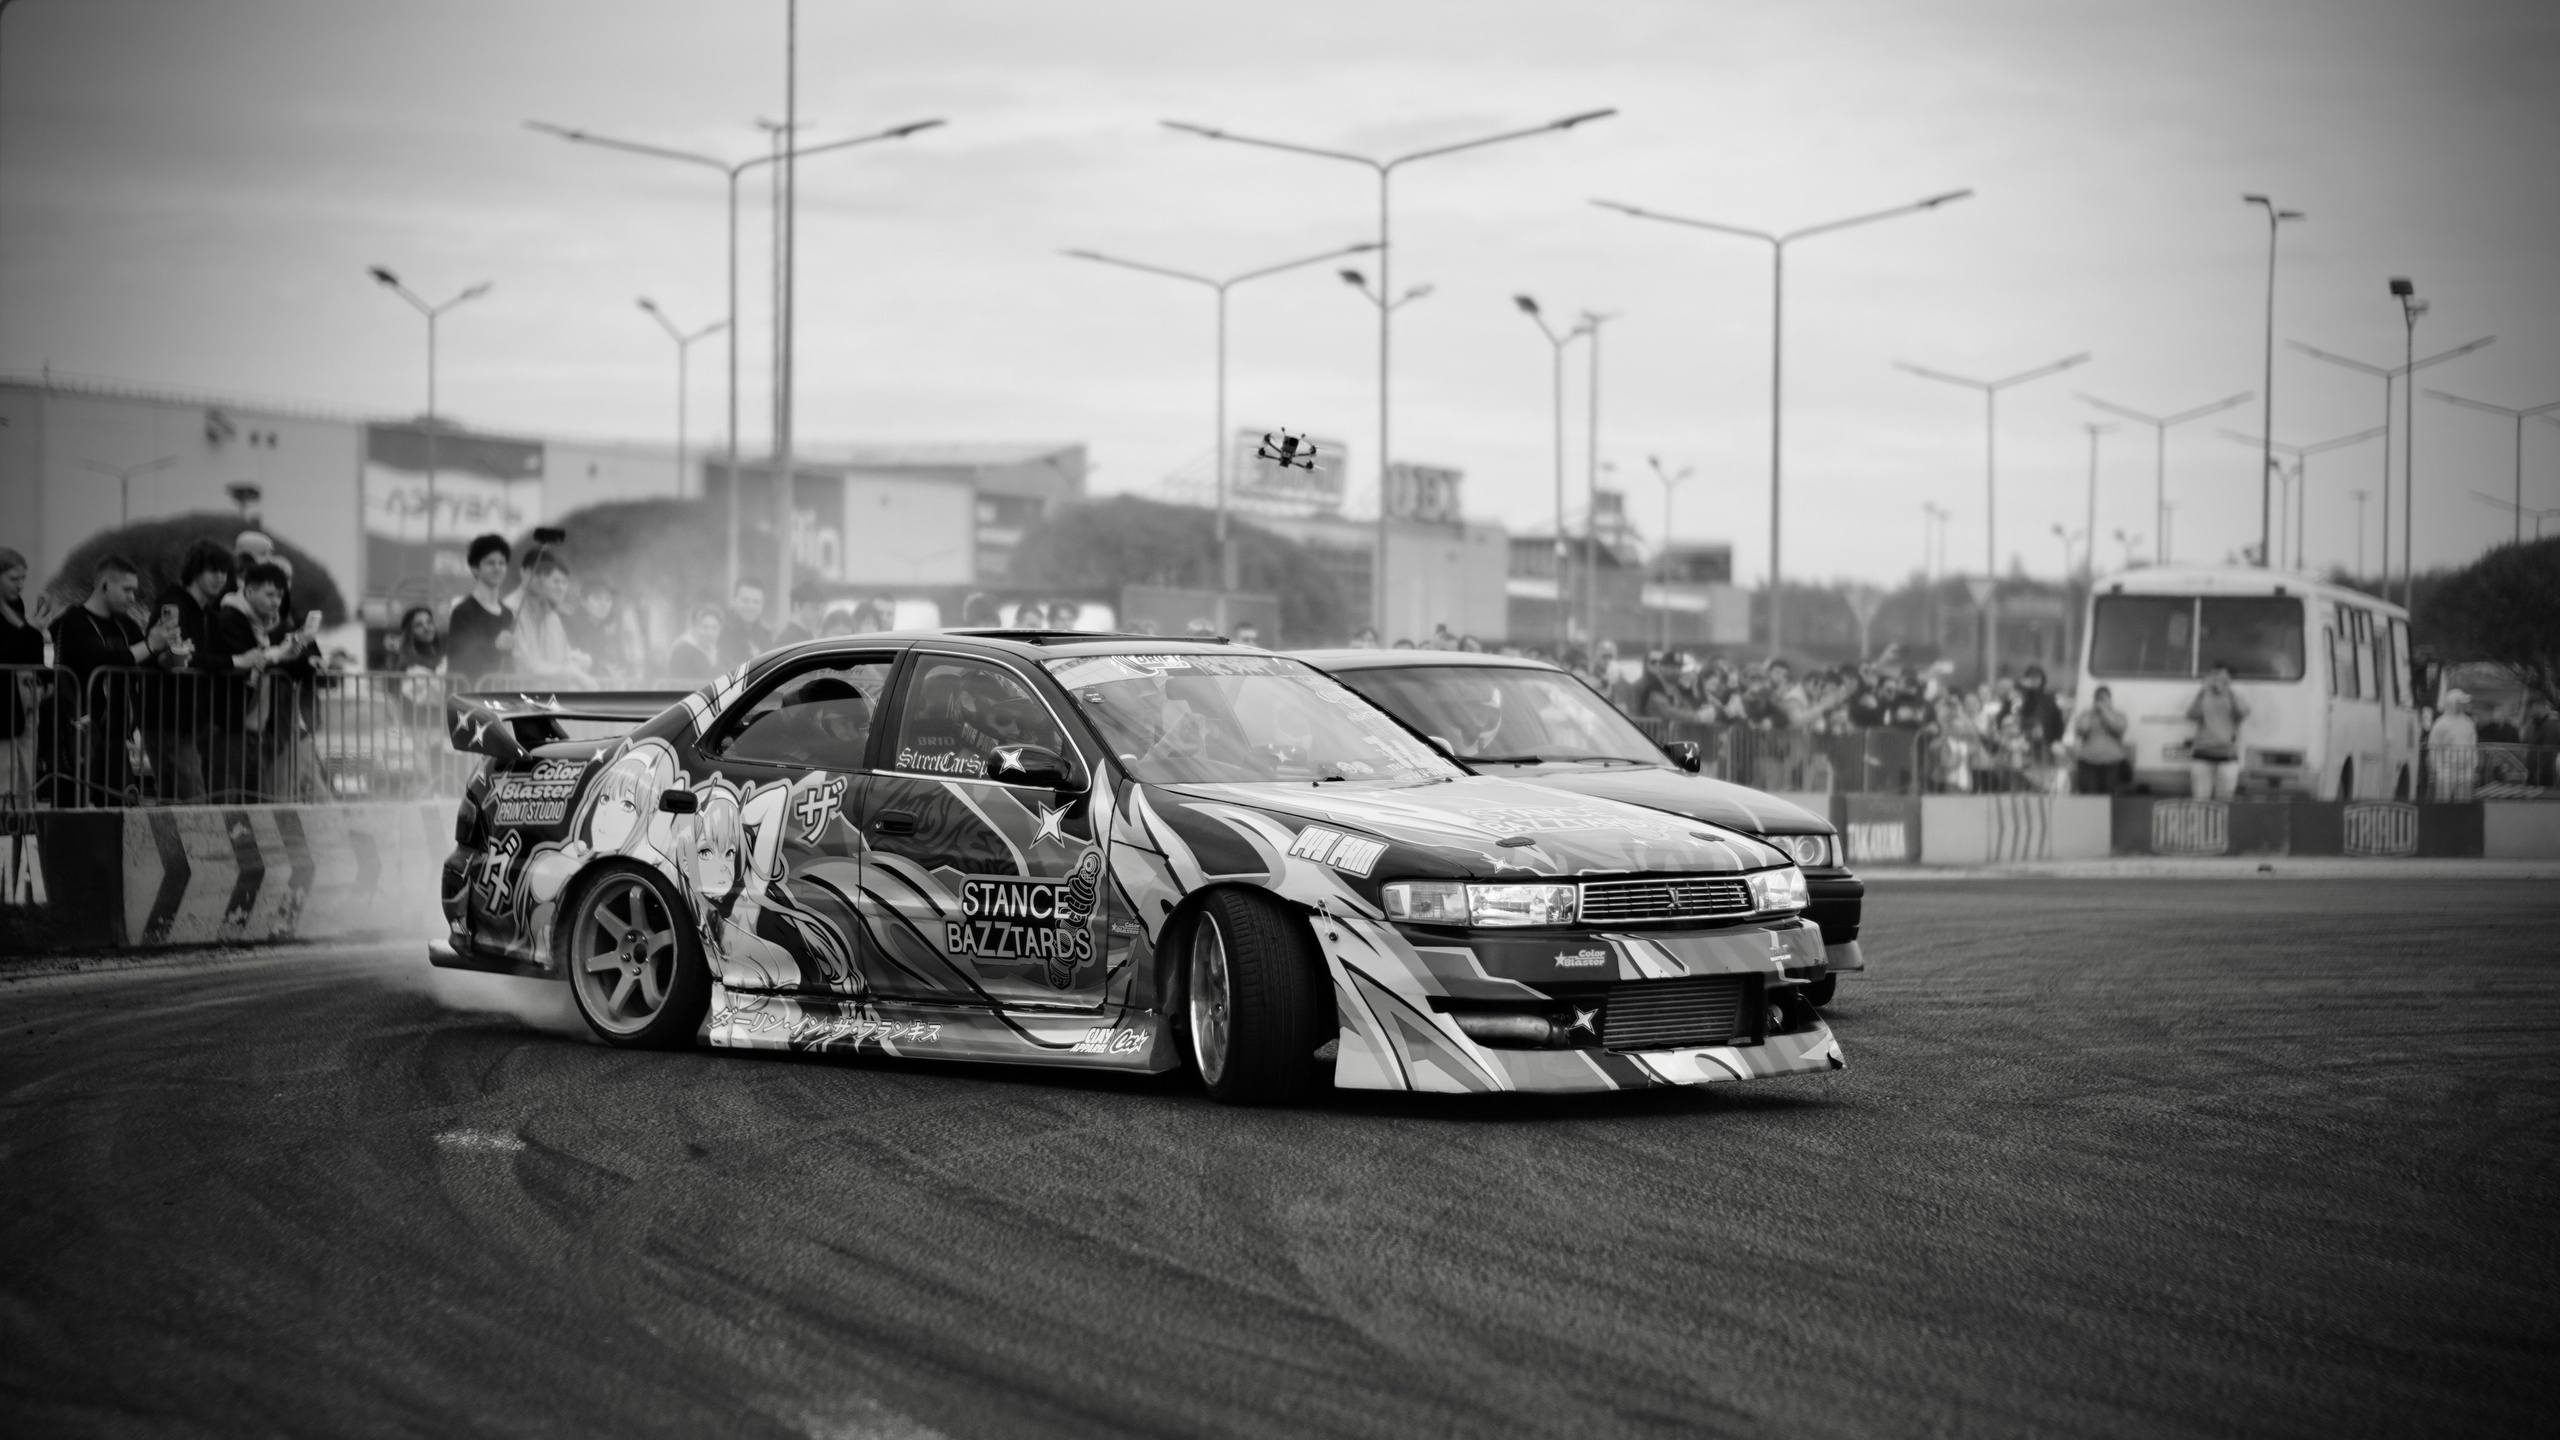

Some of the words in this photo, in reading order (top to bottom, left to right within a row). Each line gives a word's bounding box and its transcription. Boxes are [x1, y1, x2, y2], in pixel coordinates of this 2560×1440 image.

[532, 763, 583, 781] Color
[502, 782, 575, 800] Blaster
[496, 801, 528, 822] PRINT
[526, 800, 565, 821] STUDIO
[797, 779, 844, 843] ザ
[962, 881, 1070, 919] STANCE
[948, 921, 1092, 960] BAZZTARDS
[1564, 958, 1605, 967] Blaster
[1578, 949, 1606, 957] Color
